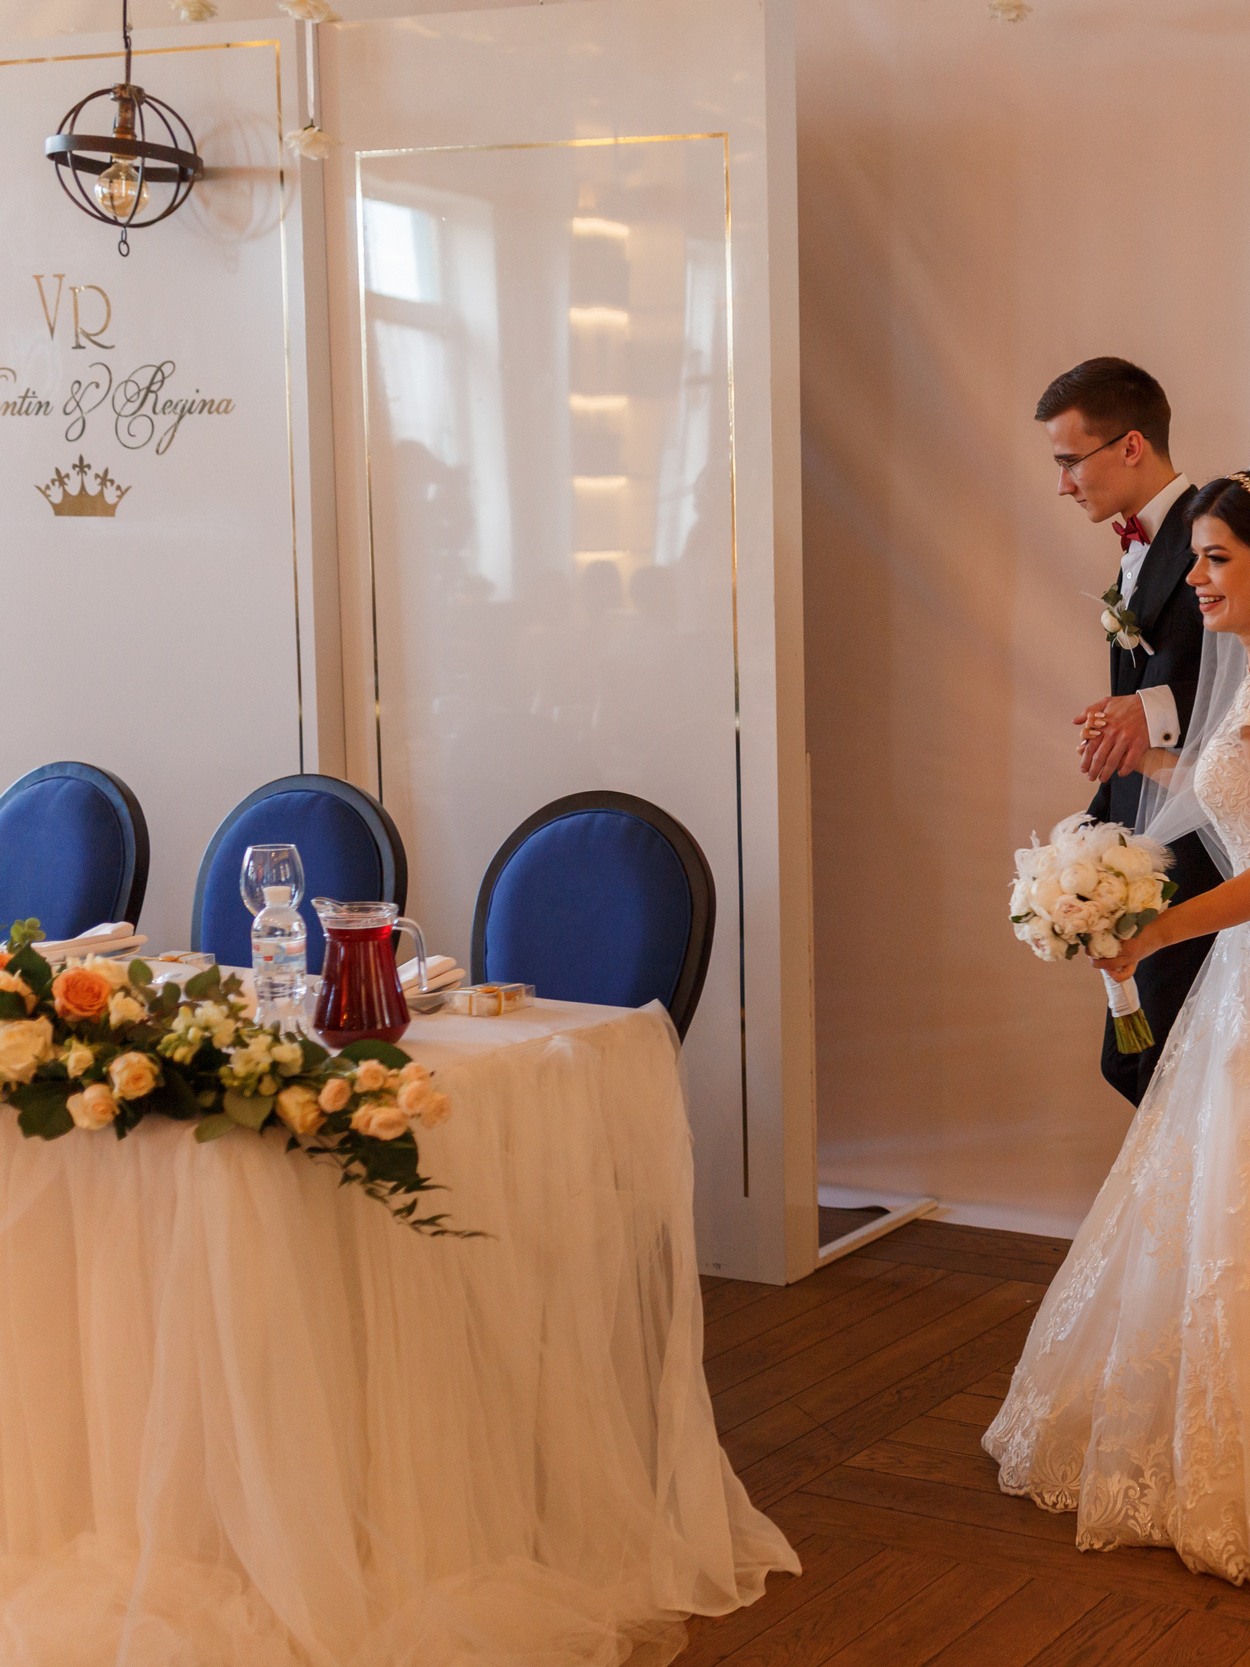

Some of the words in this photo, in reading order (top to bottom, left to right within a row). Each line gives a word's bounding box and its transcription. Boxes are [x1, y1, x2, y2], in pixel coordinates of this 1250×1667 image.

[32, 273, 116, 350] VR
[0, 367, 54, 416] ntin
[62, 361, 113, 442] &
[111, 360, 236, 455] Regina
